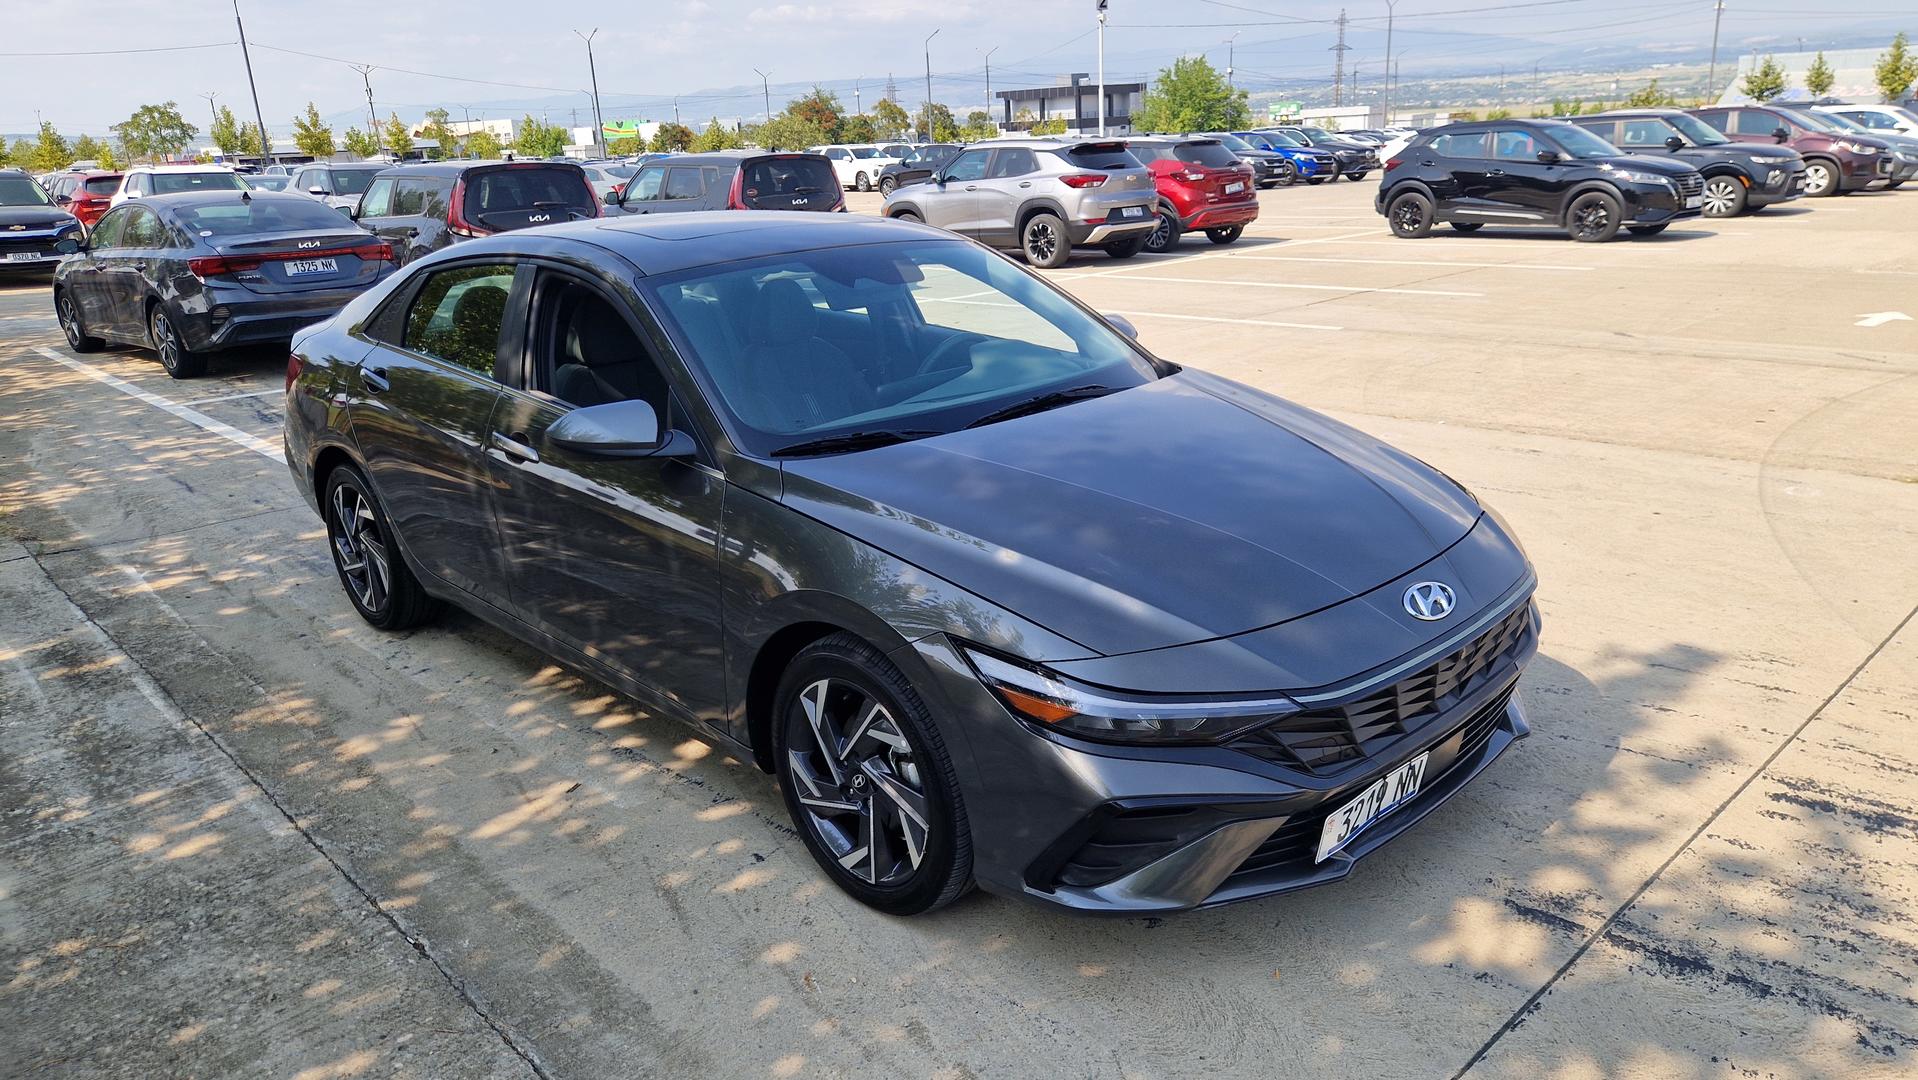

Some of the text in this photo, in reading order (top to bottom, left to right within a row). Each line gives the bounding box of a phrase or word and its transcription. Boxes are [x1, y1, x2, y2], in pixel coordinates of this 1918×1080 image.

[298, 241, 321, 249] KIA
[293, 260, 334, 273] 1325 NK
[1337, 759, 1424, 843] 3219 NN
